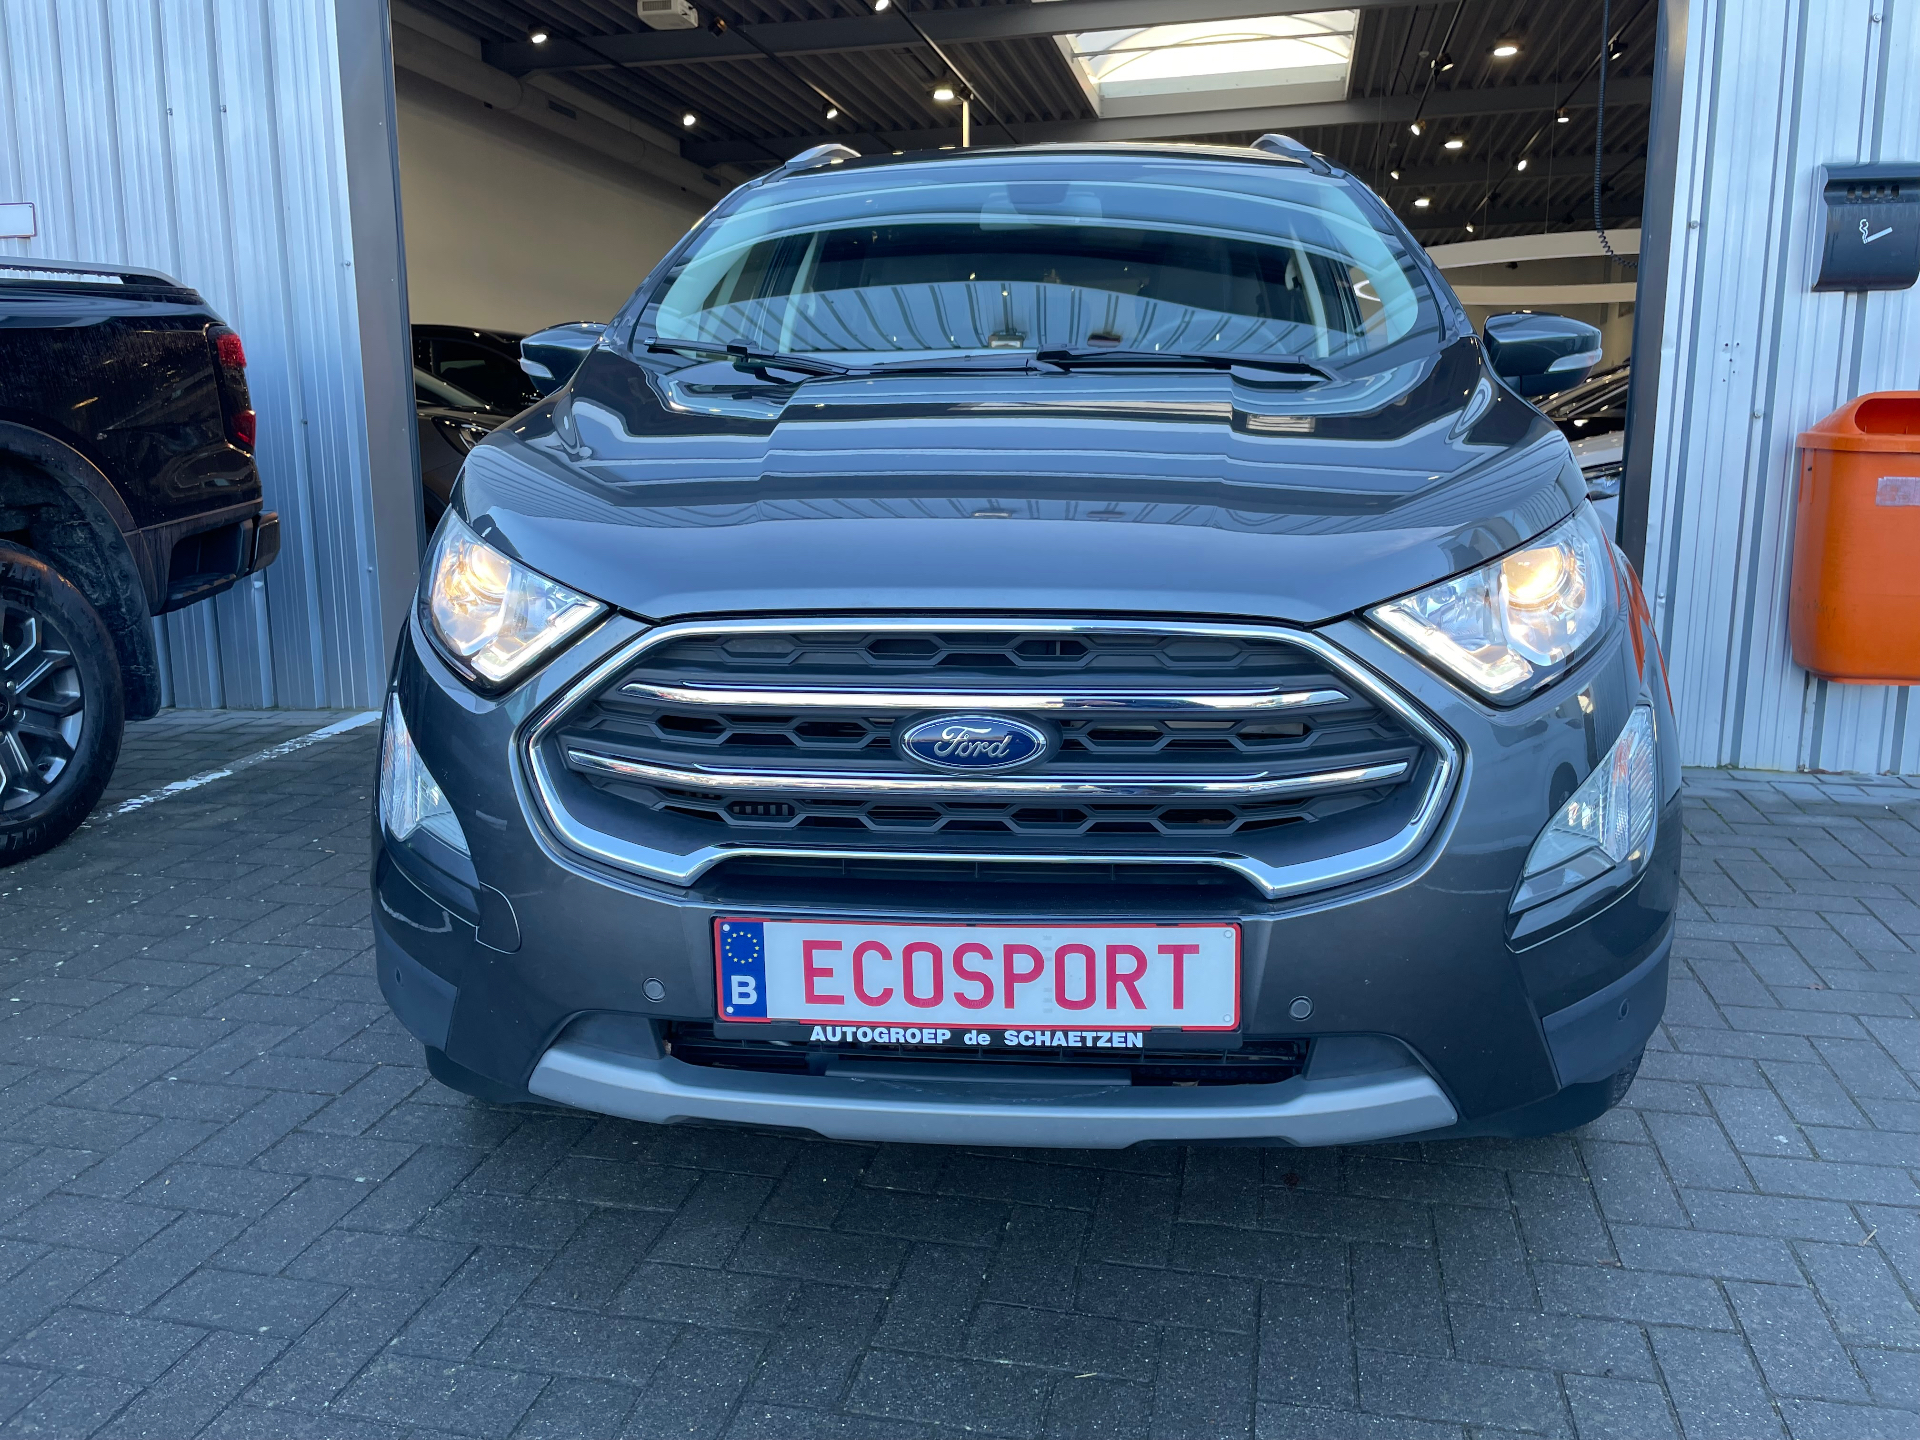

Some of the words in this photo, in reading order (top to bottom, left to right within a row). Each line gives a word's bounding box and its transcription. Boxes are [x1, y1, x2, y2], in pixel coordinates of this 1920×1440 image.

[934, 725, 1012, 758] Ford
[731, 976, 757, 1005] B
[802, 940, 1200, 1010] ECOSPORT
[810, 1026, 951, 1044] AUTOGROEP
[964, 1029, 991, 1045] de
[1003, 1030, 1144, 1048] SCHAETZEN
